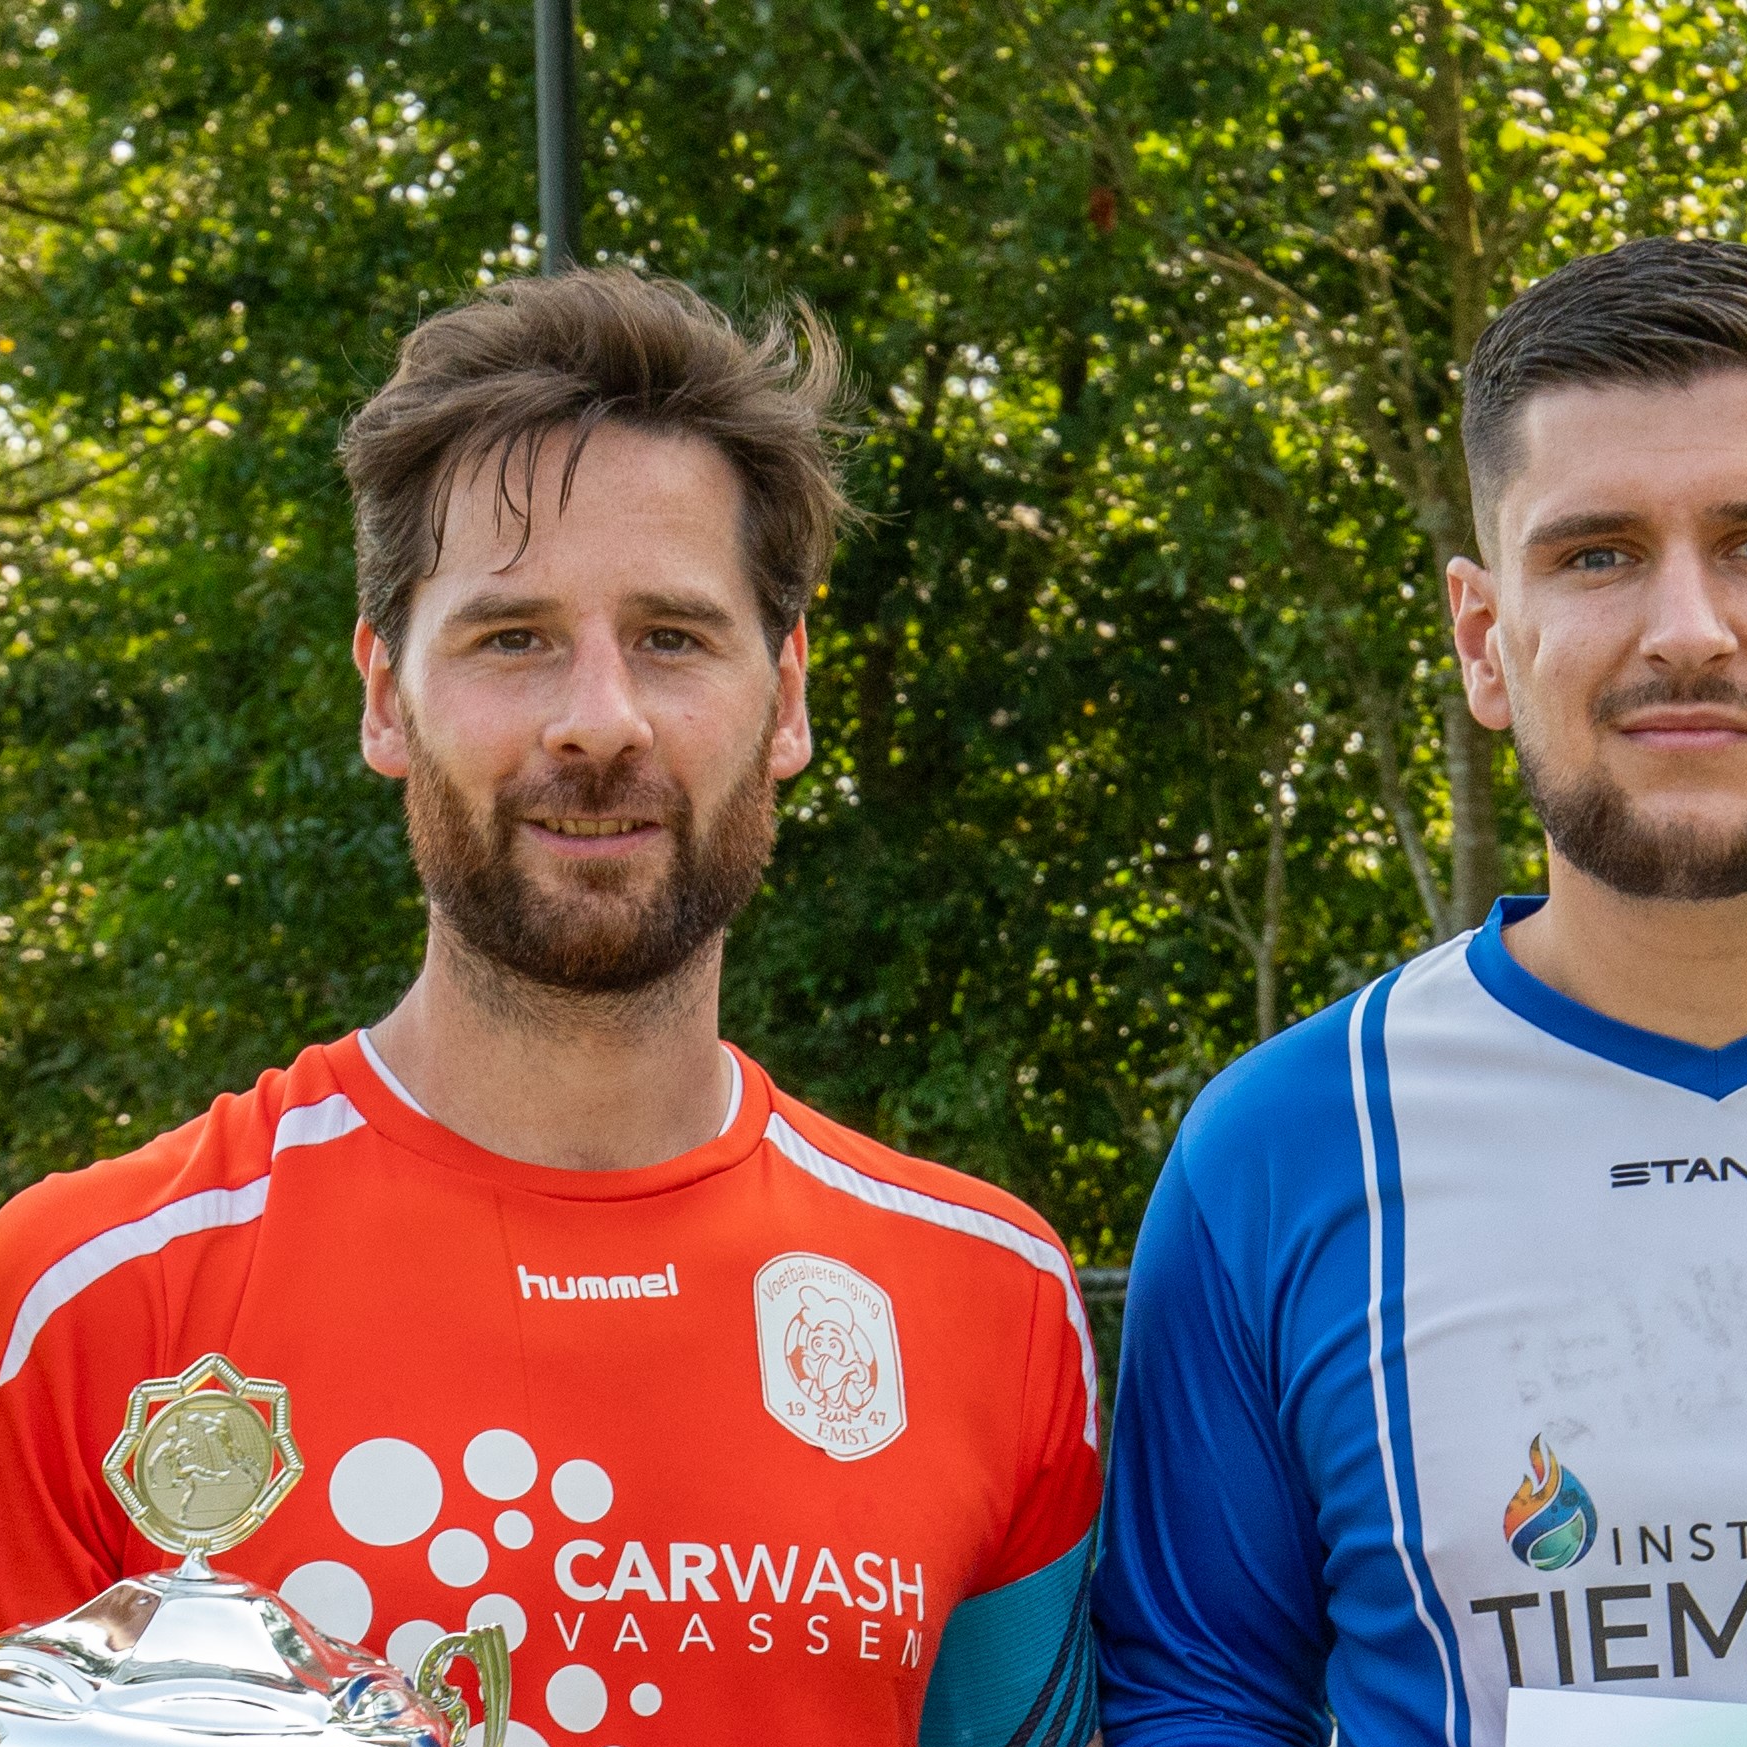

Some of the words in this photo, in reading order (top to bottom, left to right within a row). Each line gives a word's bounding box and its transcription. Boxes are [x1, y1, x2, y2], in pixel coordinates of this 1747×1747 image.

[517, 1263, 680, 1301] hummel
[762, 1260, 881, 1319] Voetbalvereniging
[786, 1401, 806, 1417] 19
[868, 1411, 887, 1427] 47
[817, 1422, 870, 1445] EMST
[554, 1540, 926, 1621] CARWASH
[553, 1612, 923, 1669] VAASSEN
